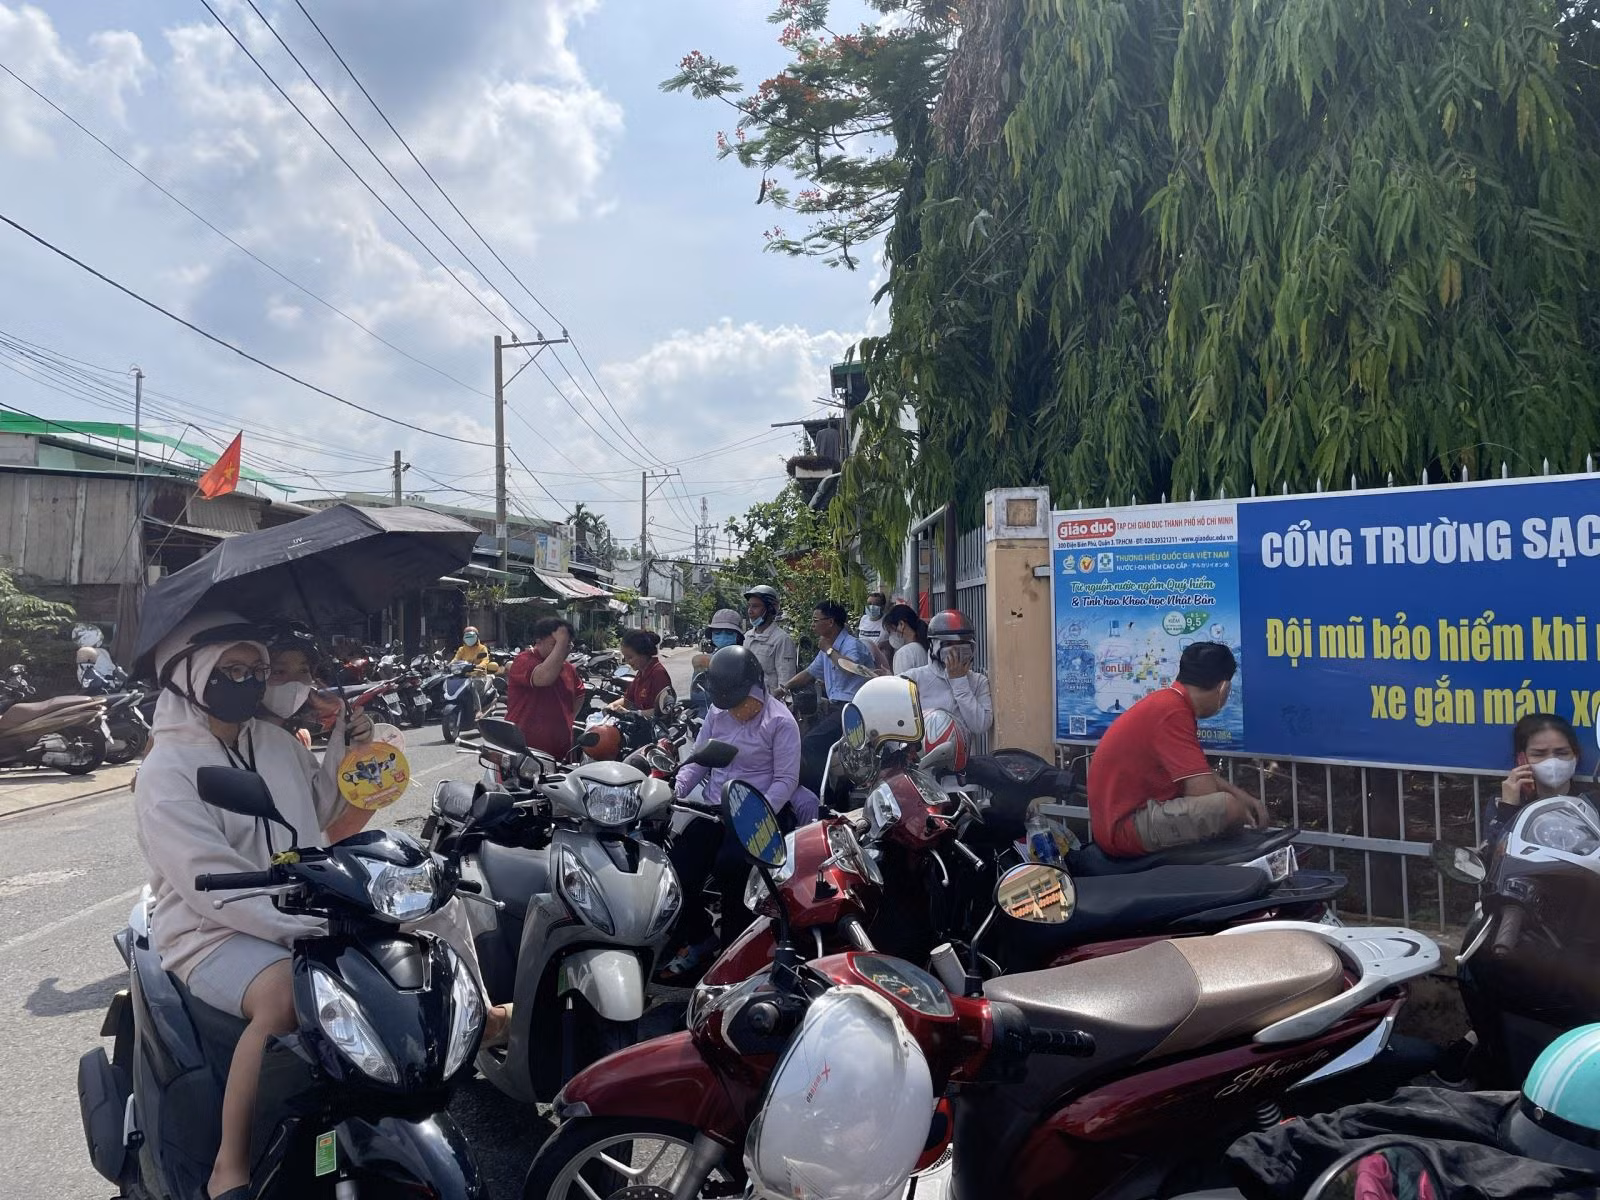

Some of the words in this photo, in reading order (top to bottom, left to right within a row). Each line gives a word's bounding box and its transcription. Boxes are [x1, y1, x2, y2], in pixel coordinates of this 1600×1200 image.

[1217, 515, 1233, 526] MINH
[1060, 523, 1088, 538] giáo
[1090, 521, 1114, 536] dục
[1262, 520, 1353, 568] CỔNG
[1361, 516, 1511, 565] TRƯỜNG
[1522, 514, 1600, 567] SẠC
[1183, 551, 1195, 560] GIA
[1213, 550, 1230, 559] NAM
[1162, 563, 1175, 571] CAO
[1085, 578, 1113, 595] nguồn
[1114, 579, 1136, 592] nước
[1166, 578, 1190, 594] Quý
[1189, 575, 1215, 590] hiếm
[1071, 596, 1080, 607] &
[1102, 595, 1121, 606] hoa
[1121, 594, 1147, 606] Khoa
[1147, 594, 1166, 609] học
[1166, 594, 1192, 609] Nhật
[1192, 593, 1216, 606] Bản
[1186, 617, 1202, 627] 9.5
[1267, 617, 1311, 667] Đội
[1320, 615, 1365, 659] mũ
[1373, 611, 1431, 661] bảo
[1439, 609, 1524, 662] hiểm
[1532, 616, 1587, 662] khi
[1371, 685, 1407, 720] xe
[1415, 674, 1475, 728] gắn
